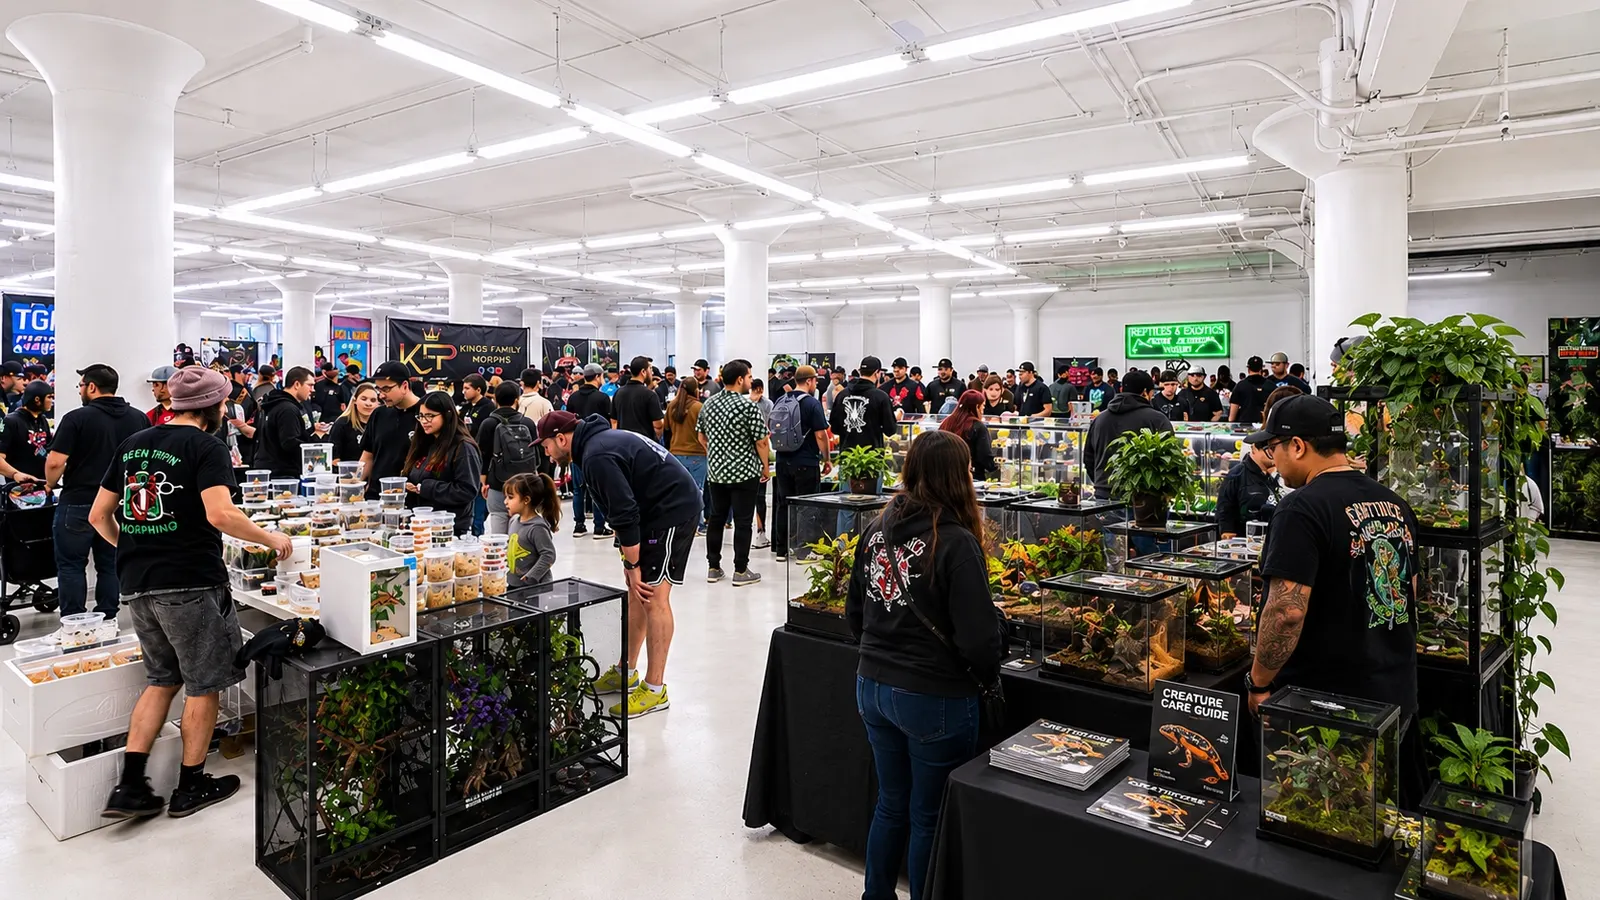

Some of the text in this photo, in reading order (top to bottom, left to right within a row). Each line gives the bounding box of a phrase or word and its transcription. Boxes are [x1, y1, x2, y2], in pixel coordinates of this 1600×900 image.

[1130, 326, 1171, 337] REPTILES
[460, 345, 488, 353] KINGS
[472, 355, 511, 364] MORPHS
[122, 448, 150, 463] BEEN
[1162, 688, 1224, 709] CREATURE
[1160, 698, 1230, 721] CARE GUIDE
